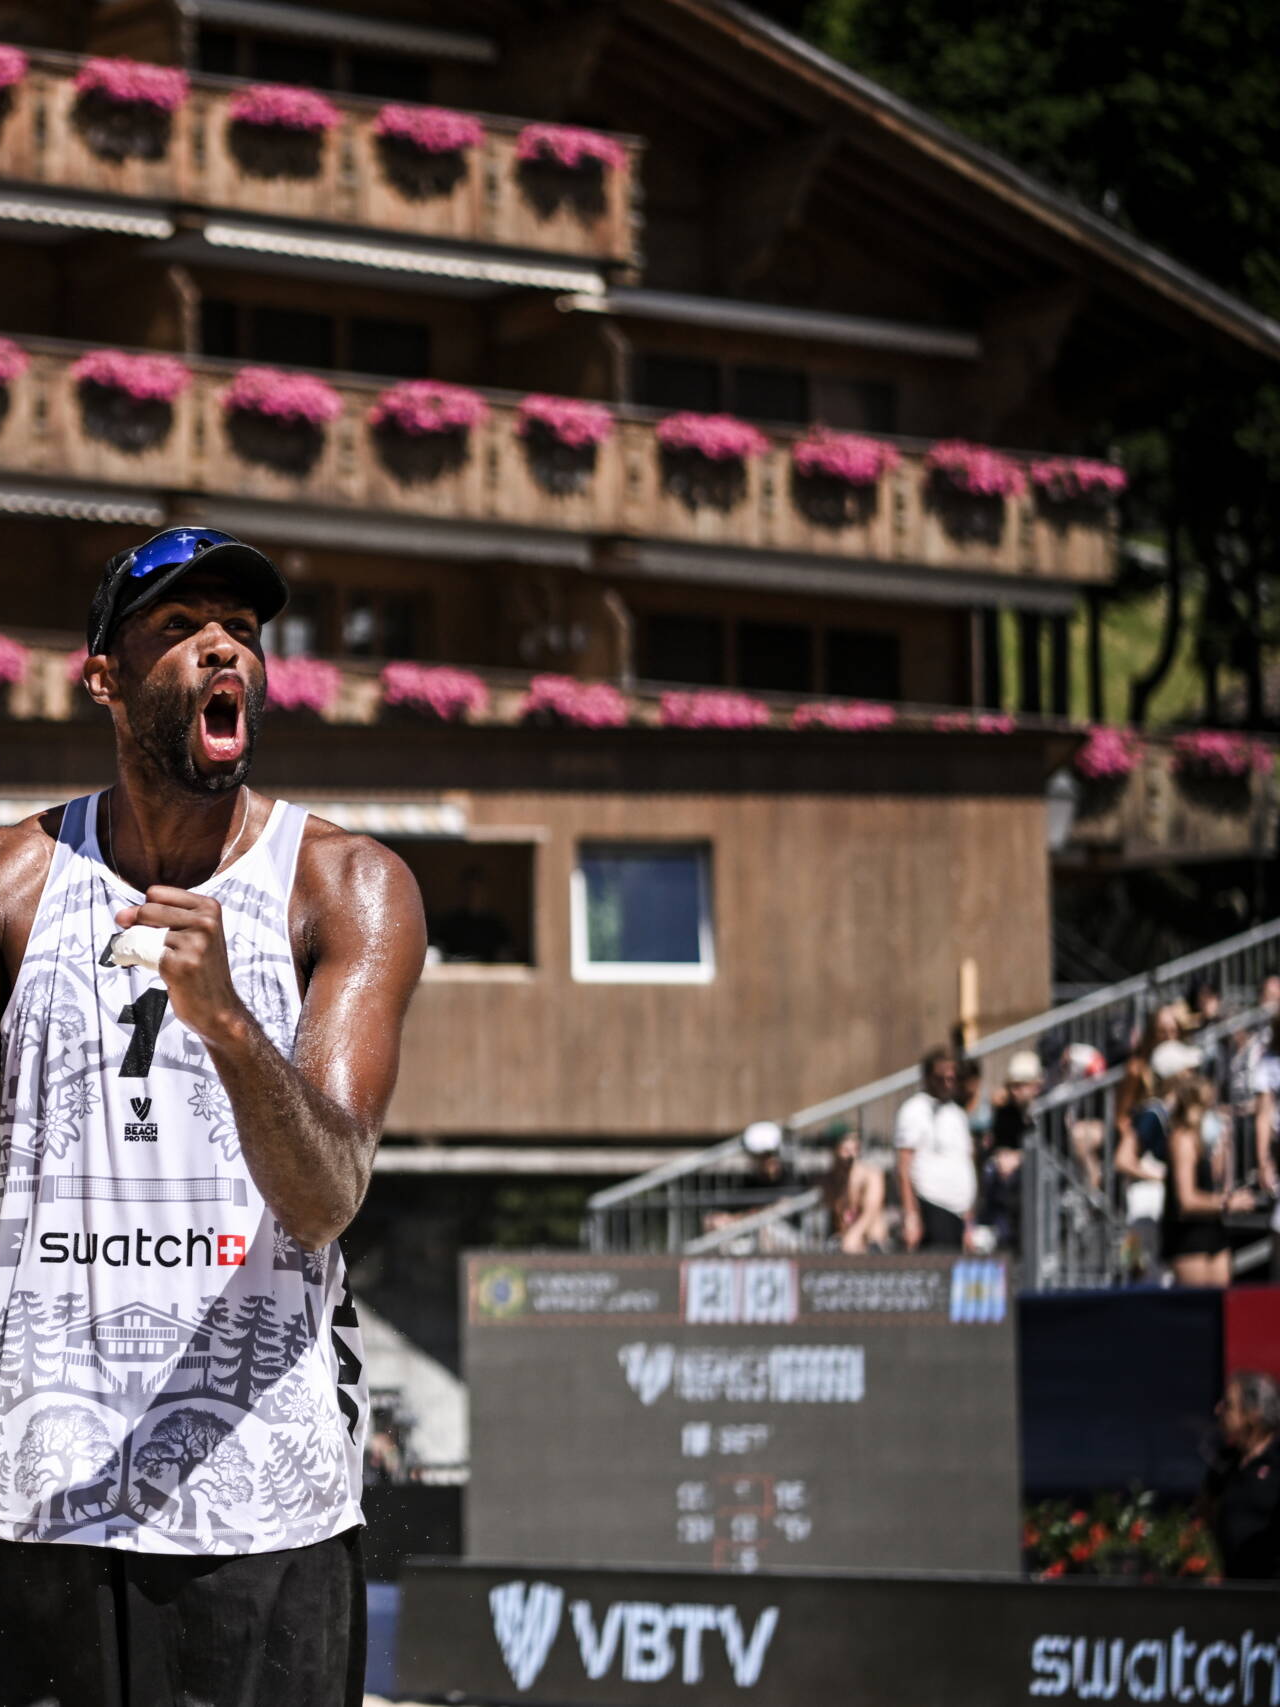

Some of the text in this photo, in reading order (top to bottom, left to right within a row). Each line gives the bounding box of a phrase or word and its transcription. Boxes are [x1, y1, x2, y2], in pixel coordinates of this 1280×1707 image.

[117, 987, 169, 1078] 1
[124, 1126, 158, 1136] BEACH
[40, 1228, 212, 1268] swatch
[569, 1599, 780, 1688] VBTV
[1029, 1627, 1280, 1706] swatch
